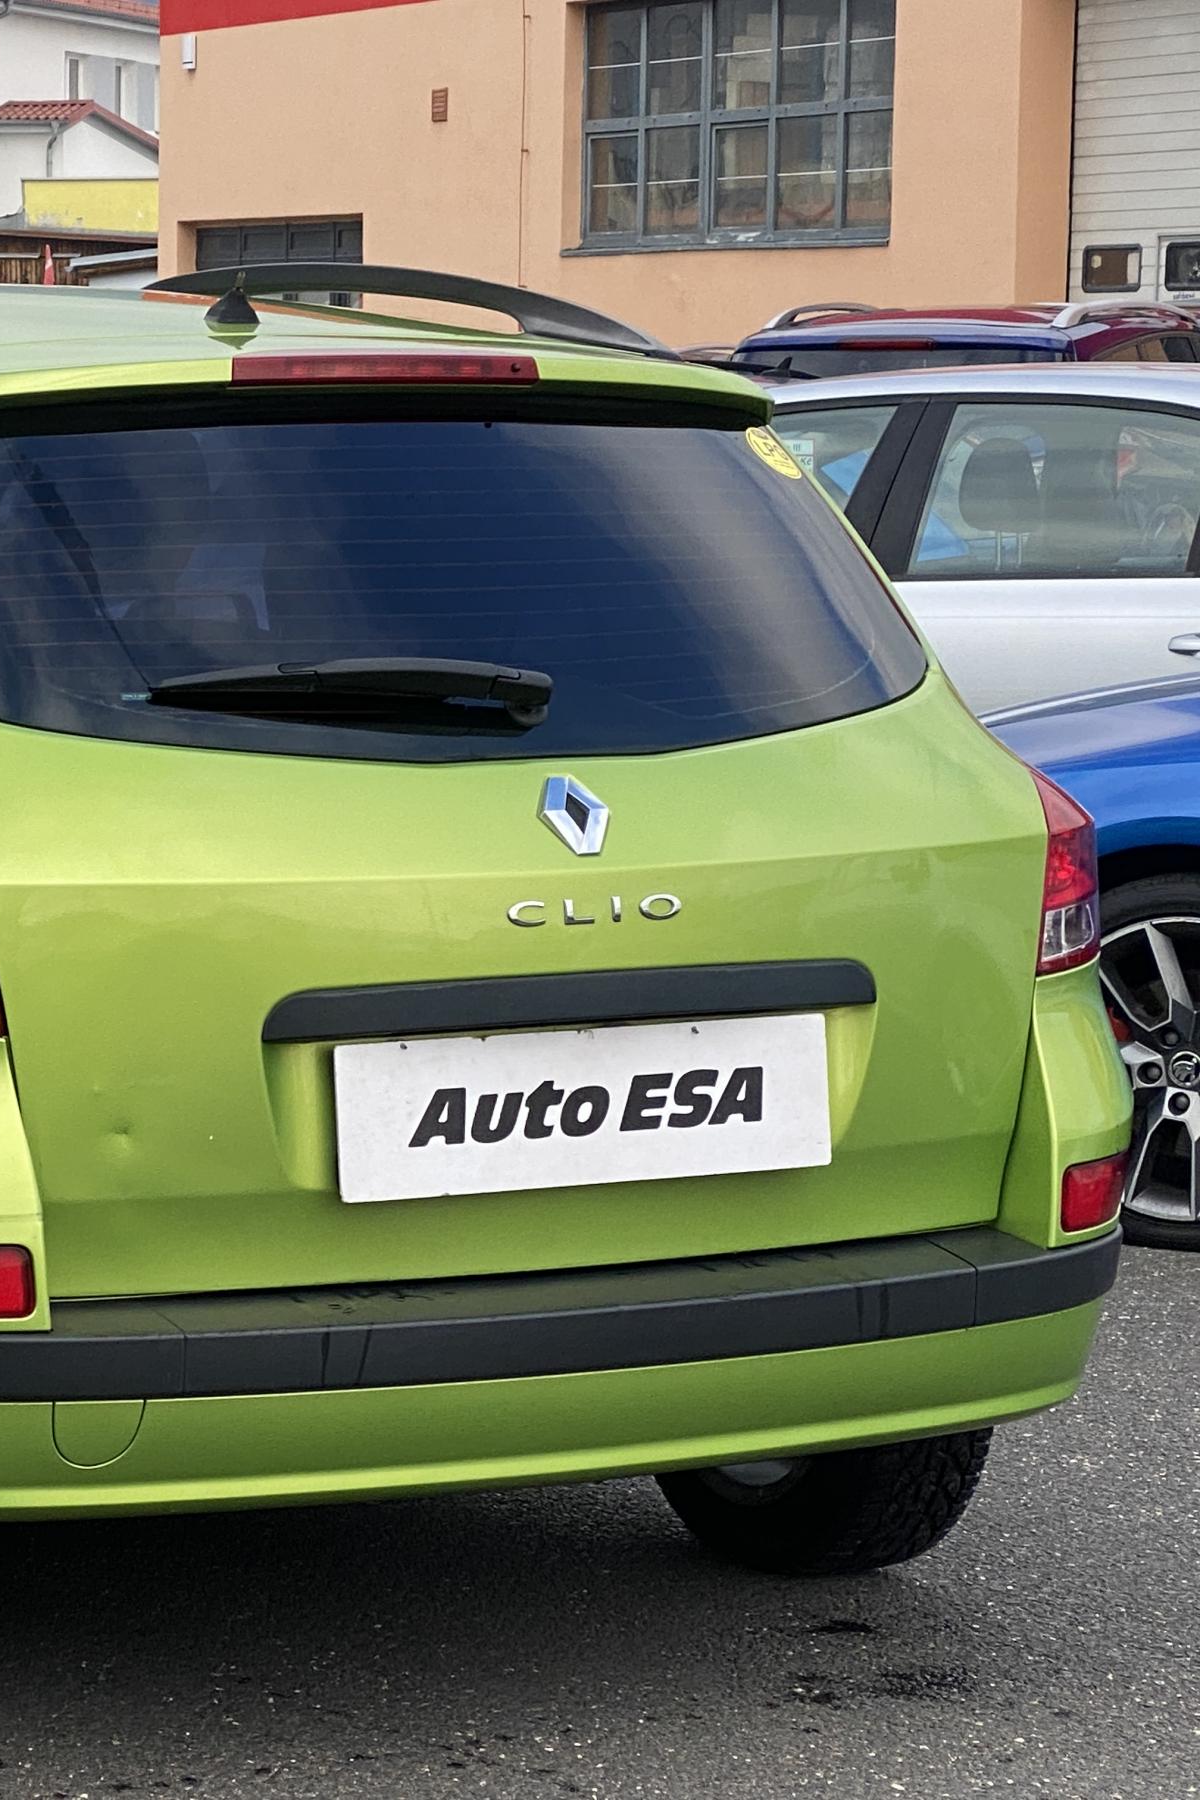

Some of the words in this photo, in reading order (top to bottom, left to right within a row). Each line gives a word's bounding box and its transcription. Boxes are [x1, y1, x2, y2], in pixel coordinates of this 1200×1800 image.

[506, 893, 682, 928] CLIO
[408, 1080, 610, 1148] Auto
[619, 1066, 764, 1132] ESA
